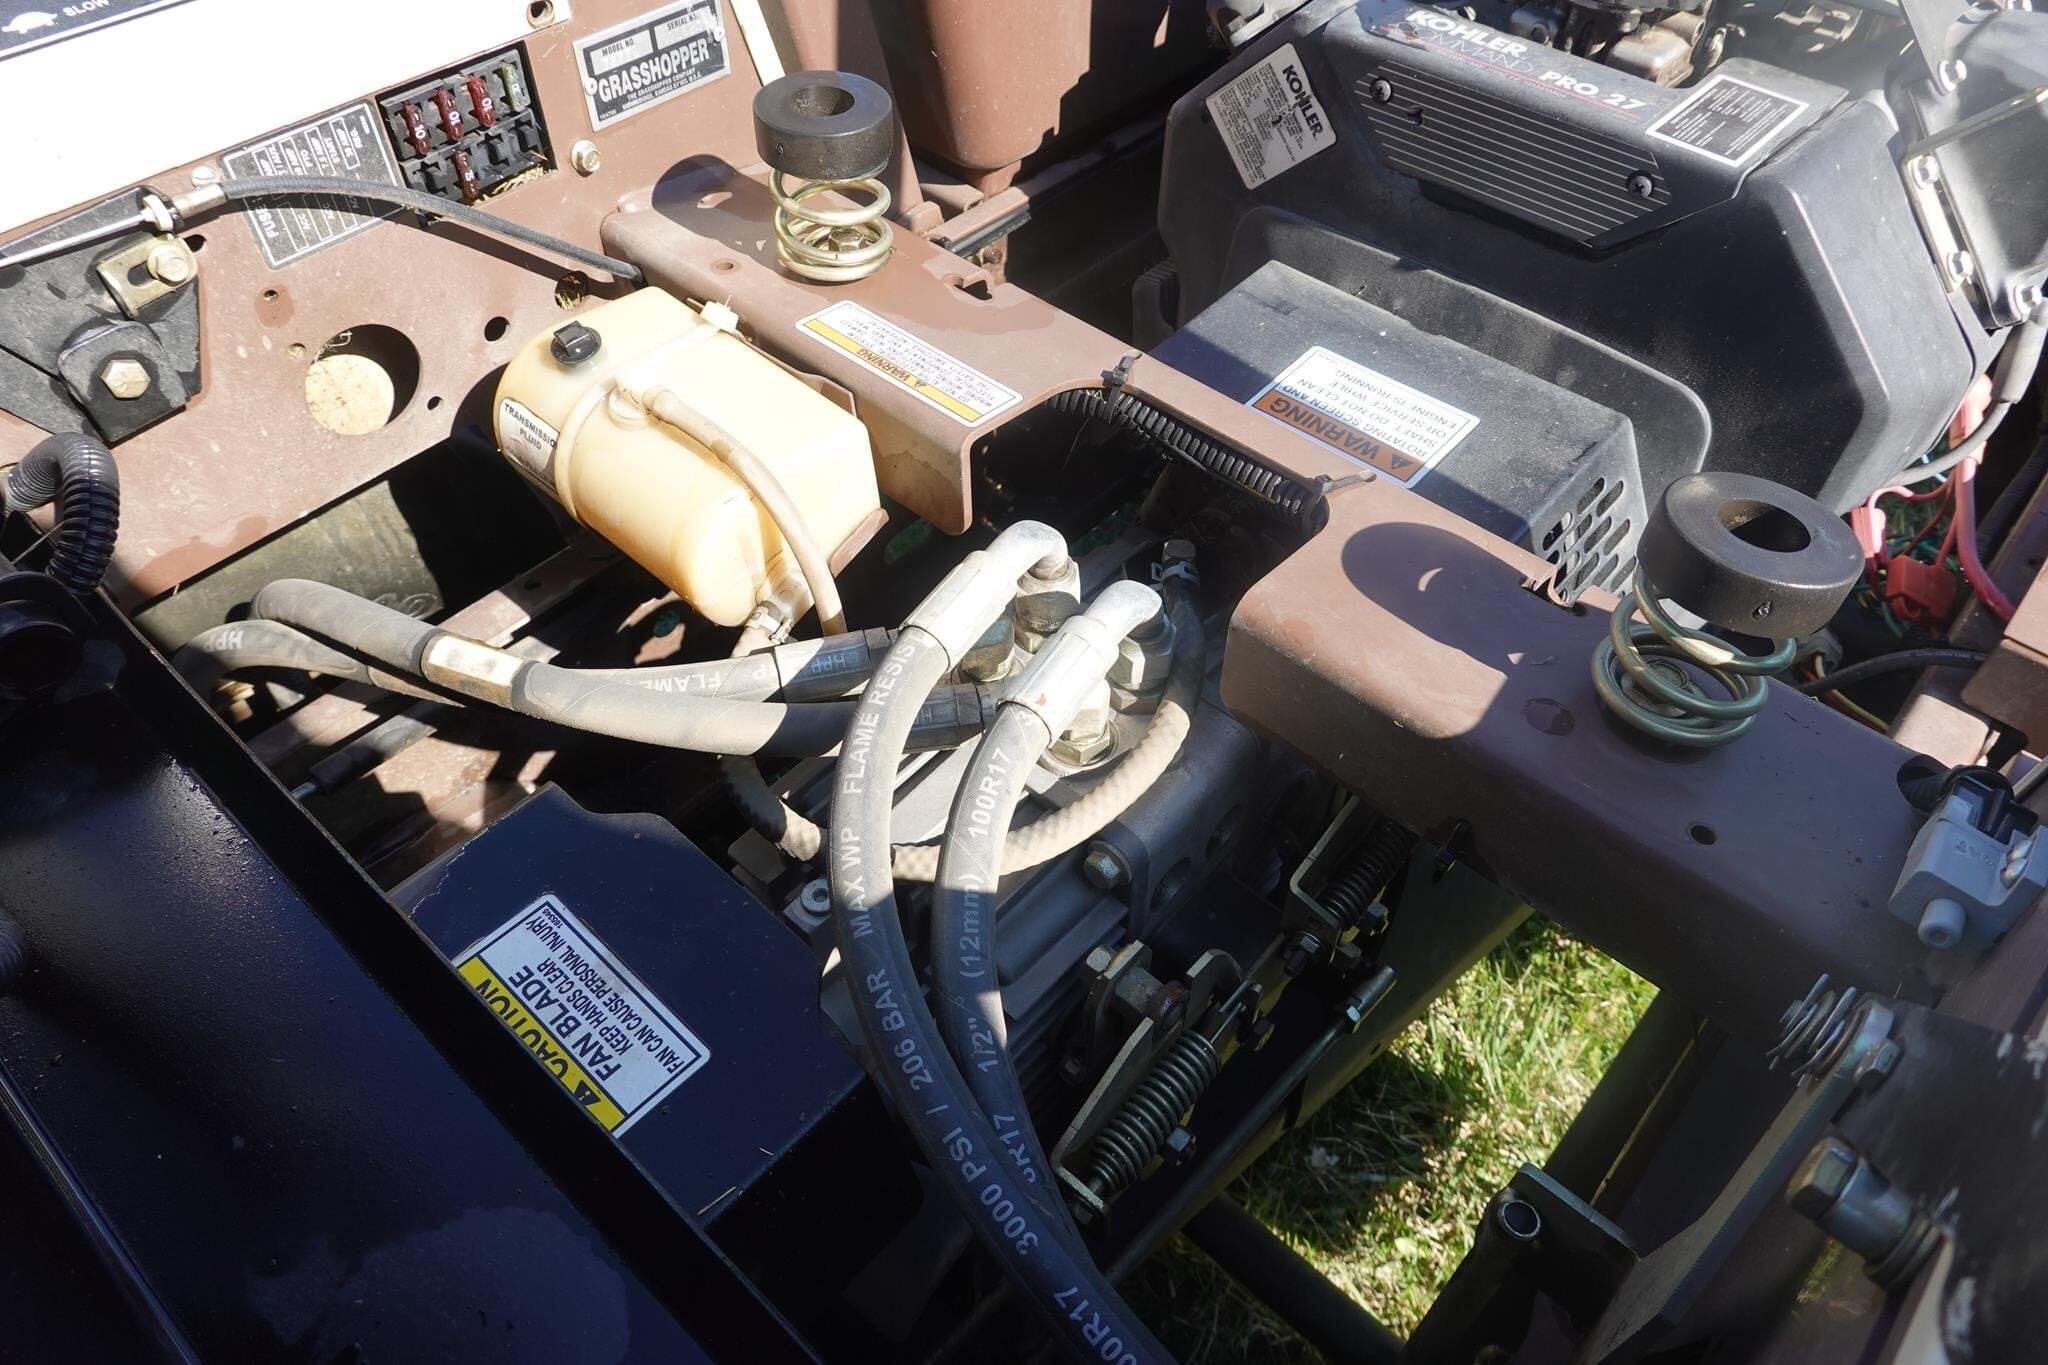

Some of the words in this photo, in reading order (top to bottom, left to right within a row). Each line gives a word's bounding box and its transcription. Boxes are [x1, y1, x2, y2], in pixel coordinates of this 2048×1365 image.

[601, 41, 623, 56] MODEL
[1406, 10, 1527, 57] KOHLER
[598, 38, 710, 102] GRASSHOPPER
[1538, 71, 1599, 97] PRO
[1604, 93, 1647, 110] 27
[1280, 63, 1326, 137] KOHLER
[414, 124, 426, 139] 10
[854, 347, 913, 381] WARNING
[1280, 384, 1311, 401] AND
[1295, 377, 1341, 401] CLEAN
[1339, 398, 1369, 415] NOT
[504, 403, 558, 449] TRANSMISSIO
[1266, 396, 1385, 459] WARNING
[1307, 397, 1363, 426] SCREEN
[1407, 403, 1458, 429] ENGINE
[519, 428, 542, 451] FLUID
[1361, 422, 1428, 457] ROTATING
[841, 710, 881, 796] FLAME
[967, 747, 1014, 839] 100R17
[840, 827, 862, 870] WP
[843, 876, 874, 939] MAX
[958, 872, 986, 979] (12mm)
[524, 913, 567, 952] INJURY
[534, 956, 576, 995] CLEAR
[554, 944, 613, 1000] PERSONAL
[506, 964, 583, 1039] BLADE
[564, 987, 608, 1029] HANDS
[600, 991, 644, 1032] CAUSE
[866, 967, 907, 1033] BAR
[572, 1031, 622, 1082] FAN
[597, 1020, 634, 1056] KEEP
[632, 1023, 665, 1053] CAN
[653, 1044, 685, 1073] FAN
[895, 1038, 935, 1092] 206
[942, 1126, 988, 1184] PSI
[979, 1183, 1041, 1257] 3000
